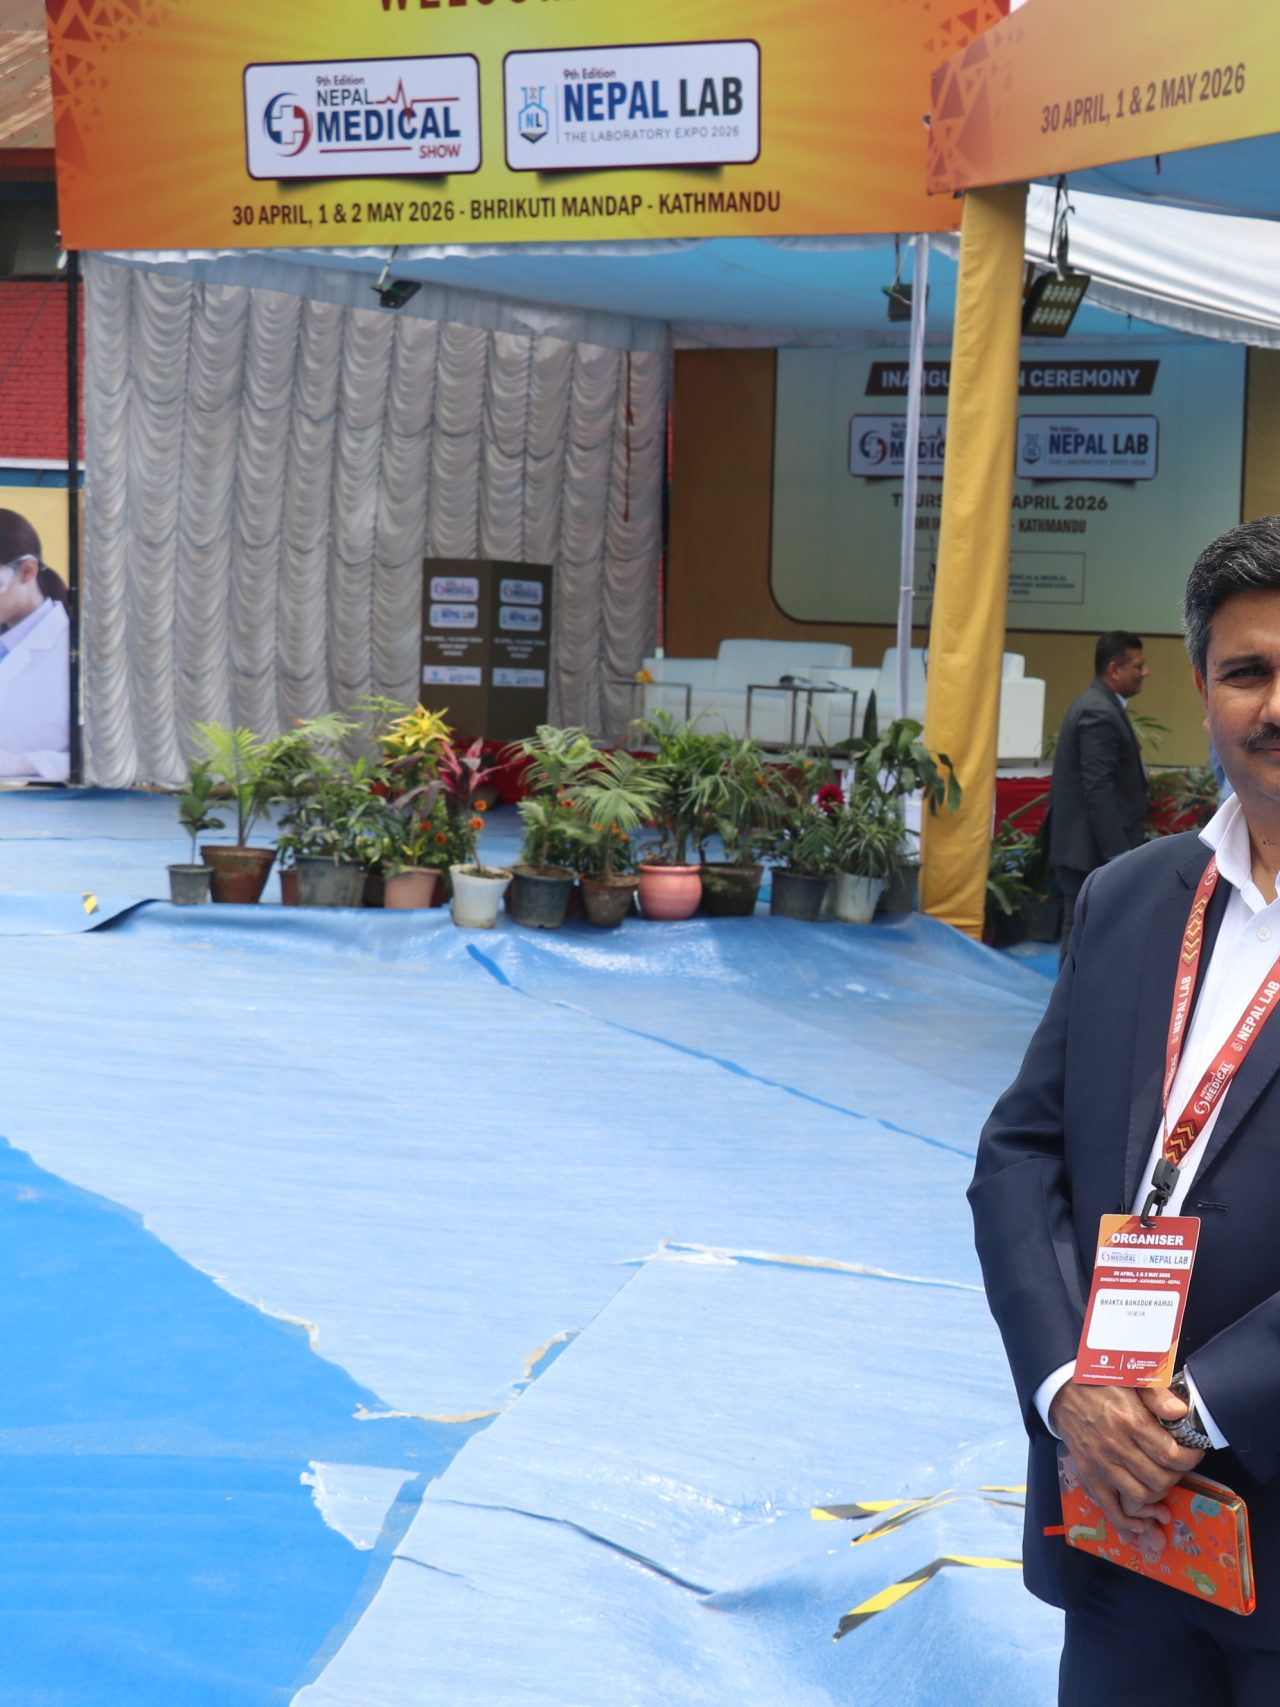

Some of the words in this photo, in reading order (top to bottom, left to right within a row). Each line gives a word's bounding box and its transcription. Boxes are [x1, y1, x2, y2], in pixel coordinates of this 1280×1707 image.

[316, 76, 331, 87] 9th
[334, 75, 366, 86] Edition
[564, 69, 580, 80] 9th
[582, 68, 616, 80] Edition
[316, 88, 376, 107] NEPAL
[564, 80, 669, 123] NEPAL
[679, 77, 743, 117] LAB
[1041, 104, 1060, 134] 30
[1062, 94, 1111, 129] APRIL,
[1116, 89, 1125, 119] 1
[1129, 85, 1142, 116] &
[1145, 82, 1156, 112] 2
[1160, 72, 1197, 110] MAY
[1200, 63, 1246, 101] 2026
[317, 106, 461, 142] MEDICAL
[565, 131, 588, 142] THE
[591, 128, 671, 142] LABORATORY
[675, 126, 709, 140] EXPO
[711, 125, 740, 138] 2026
[419, 144, 461, 159] SHOW
[232, 205, 254, 225] 30
[259, 204, 314, 229] APRIL,
[319, 205, 328, 224] 1
[334, 204, 347, 223] &
[351, 203, 362, 223] 2
[368, 202, 403, 222] MAY
[408, 201, 455, 221] 2026
[471, 197, 556, 220] BHRIKUTI
[562, 195, 643, 217] MANDAP
[659, 191, 781, 214] KATHMANDU
[1030, 368, 1140, 388] CEREMONY
[1049, 433, 1107, 455] NEPAL
[1113, 433, 1149, 455] LAB
[1012, 495, 1060, 510] APRIL
[1064, 496, 1108, 511] 2026
[1019, 518, 1087, 533] KATHMANDU
[1179, 975, 1192, 998] LAB
[1173, 998, 1188, 1034] NEPAL
[1237, 1004, 1267, 1042] NEPAL
[1259, 980, 1280, 1004] LAB
[1204, 1062, 1233, 1103] MEDICAL
[1111, 1232, 1184, 1246] ORGANISER
[1110, 1254, 1136, 1262] MEDICAL
[1149, 1255, 1172, 1264] NEPAL
[1174, 1256, 1189, 1265] LAB
[1125, 1299, 1152, 1307] BAHADUR
